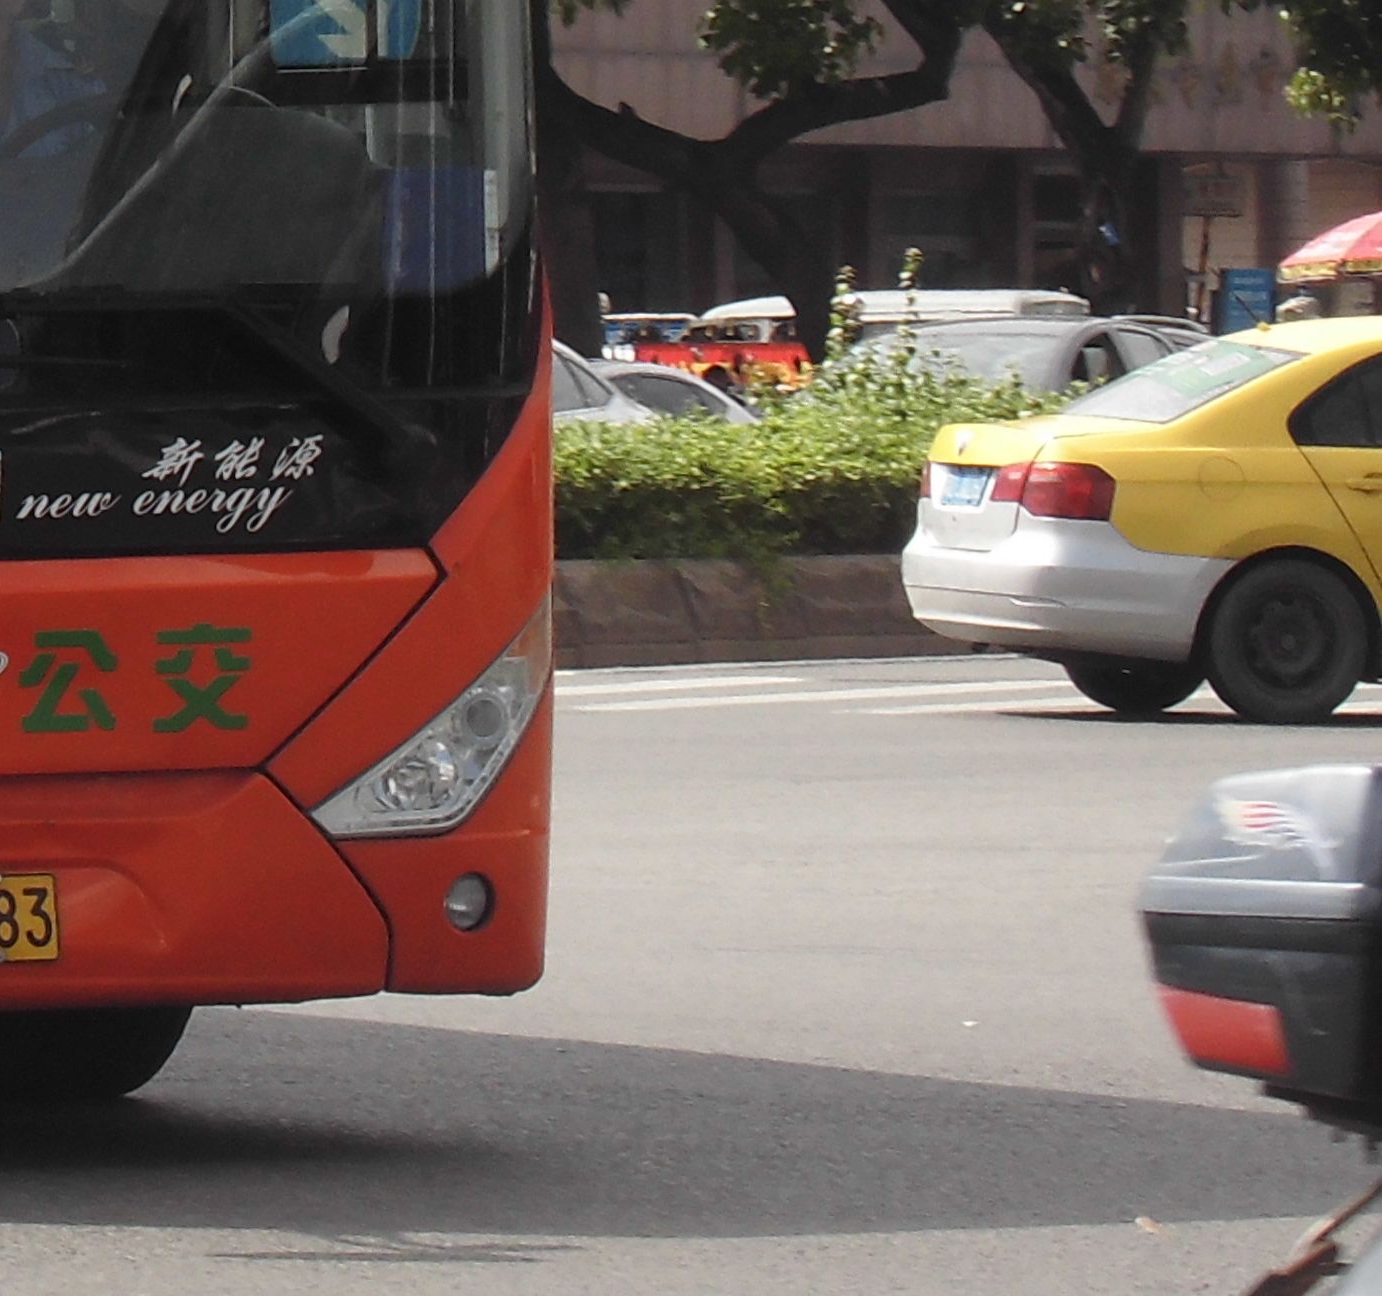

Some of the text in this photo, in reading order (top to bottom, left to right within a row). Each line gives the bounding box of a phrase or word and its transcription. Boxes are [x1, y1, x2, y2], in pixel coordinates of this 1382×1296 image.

[141, 433, 325, 488] 新能源
[15, 484, 295, 535] new energy
[19, 622, 253, 734] 公交
